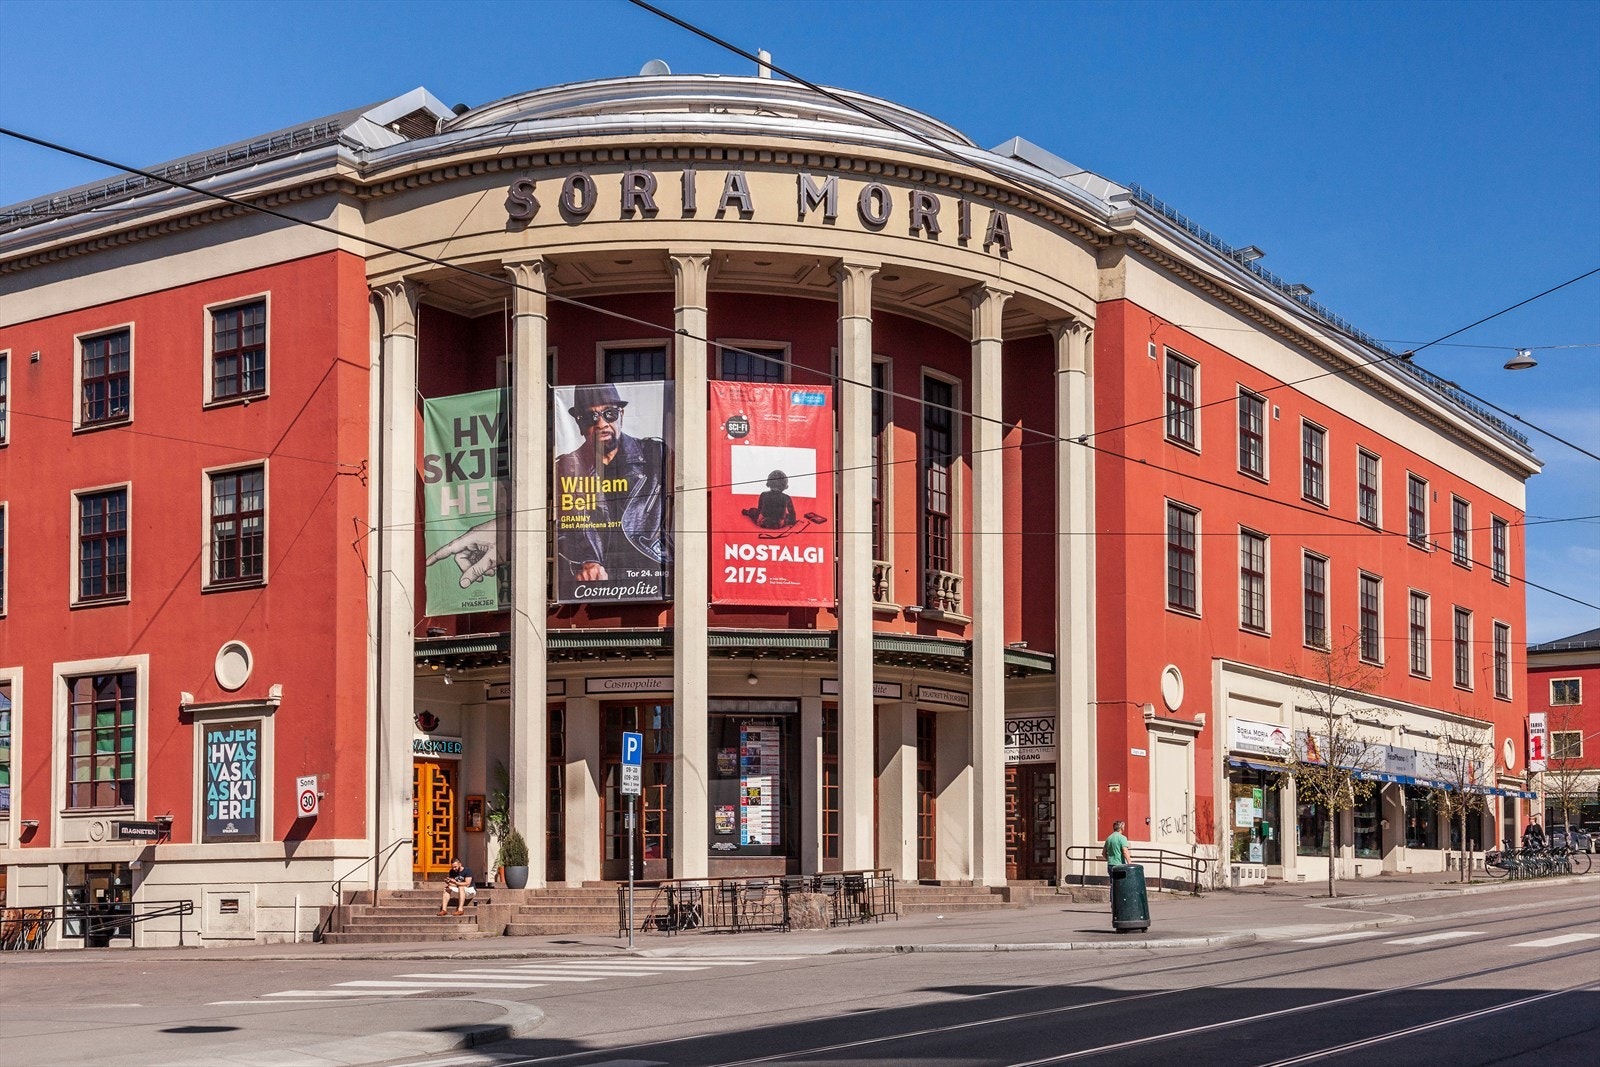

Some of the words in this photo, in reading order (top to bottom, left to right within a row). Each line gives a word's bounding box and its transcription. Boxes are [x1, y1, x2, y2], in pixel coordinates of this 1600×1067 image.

[505, 169, 754, 222] SORIA
[799, 173, 1013, 252] MORIA
[728, 423, 748, 432] SCI-FI
[561, 476, 628, 493] William
[561, 493, 596, 511] Bell
[560, 515, 591, 523] GRAMMY
[724, 543, 824, 564] NOSTALGI
[626, 570, 640, 578] Tor
[641, 569, 653, 577] 24.
[724, 566, 767, 584] 2175
[574, 581, 659, 600] Cosmopolite
[603, 679, 662, 690] Cosmopolite
[1012, 731, 1055, 746] TEATRET
[627, 737, 638, 761] P
[1530, 735, 1545, 761] 1
[299, 779, 315, 787] Sone
[302, 795, 314, 808] 30
[121, 827, 156, 835] MAGNETEN
